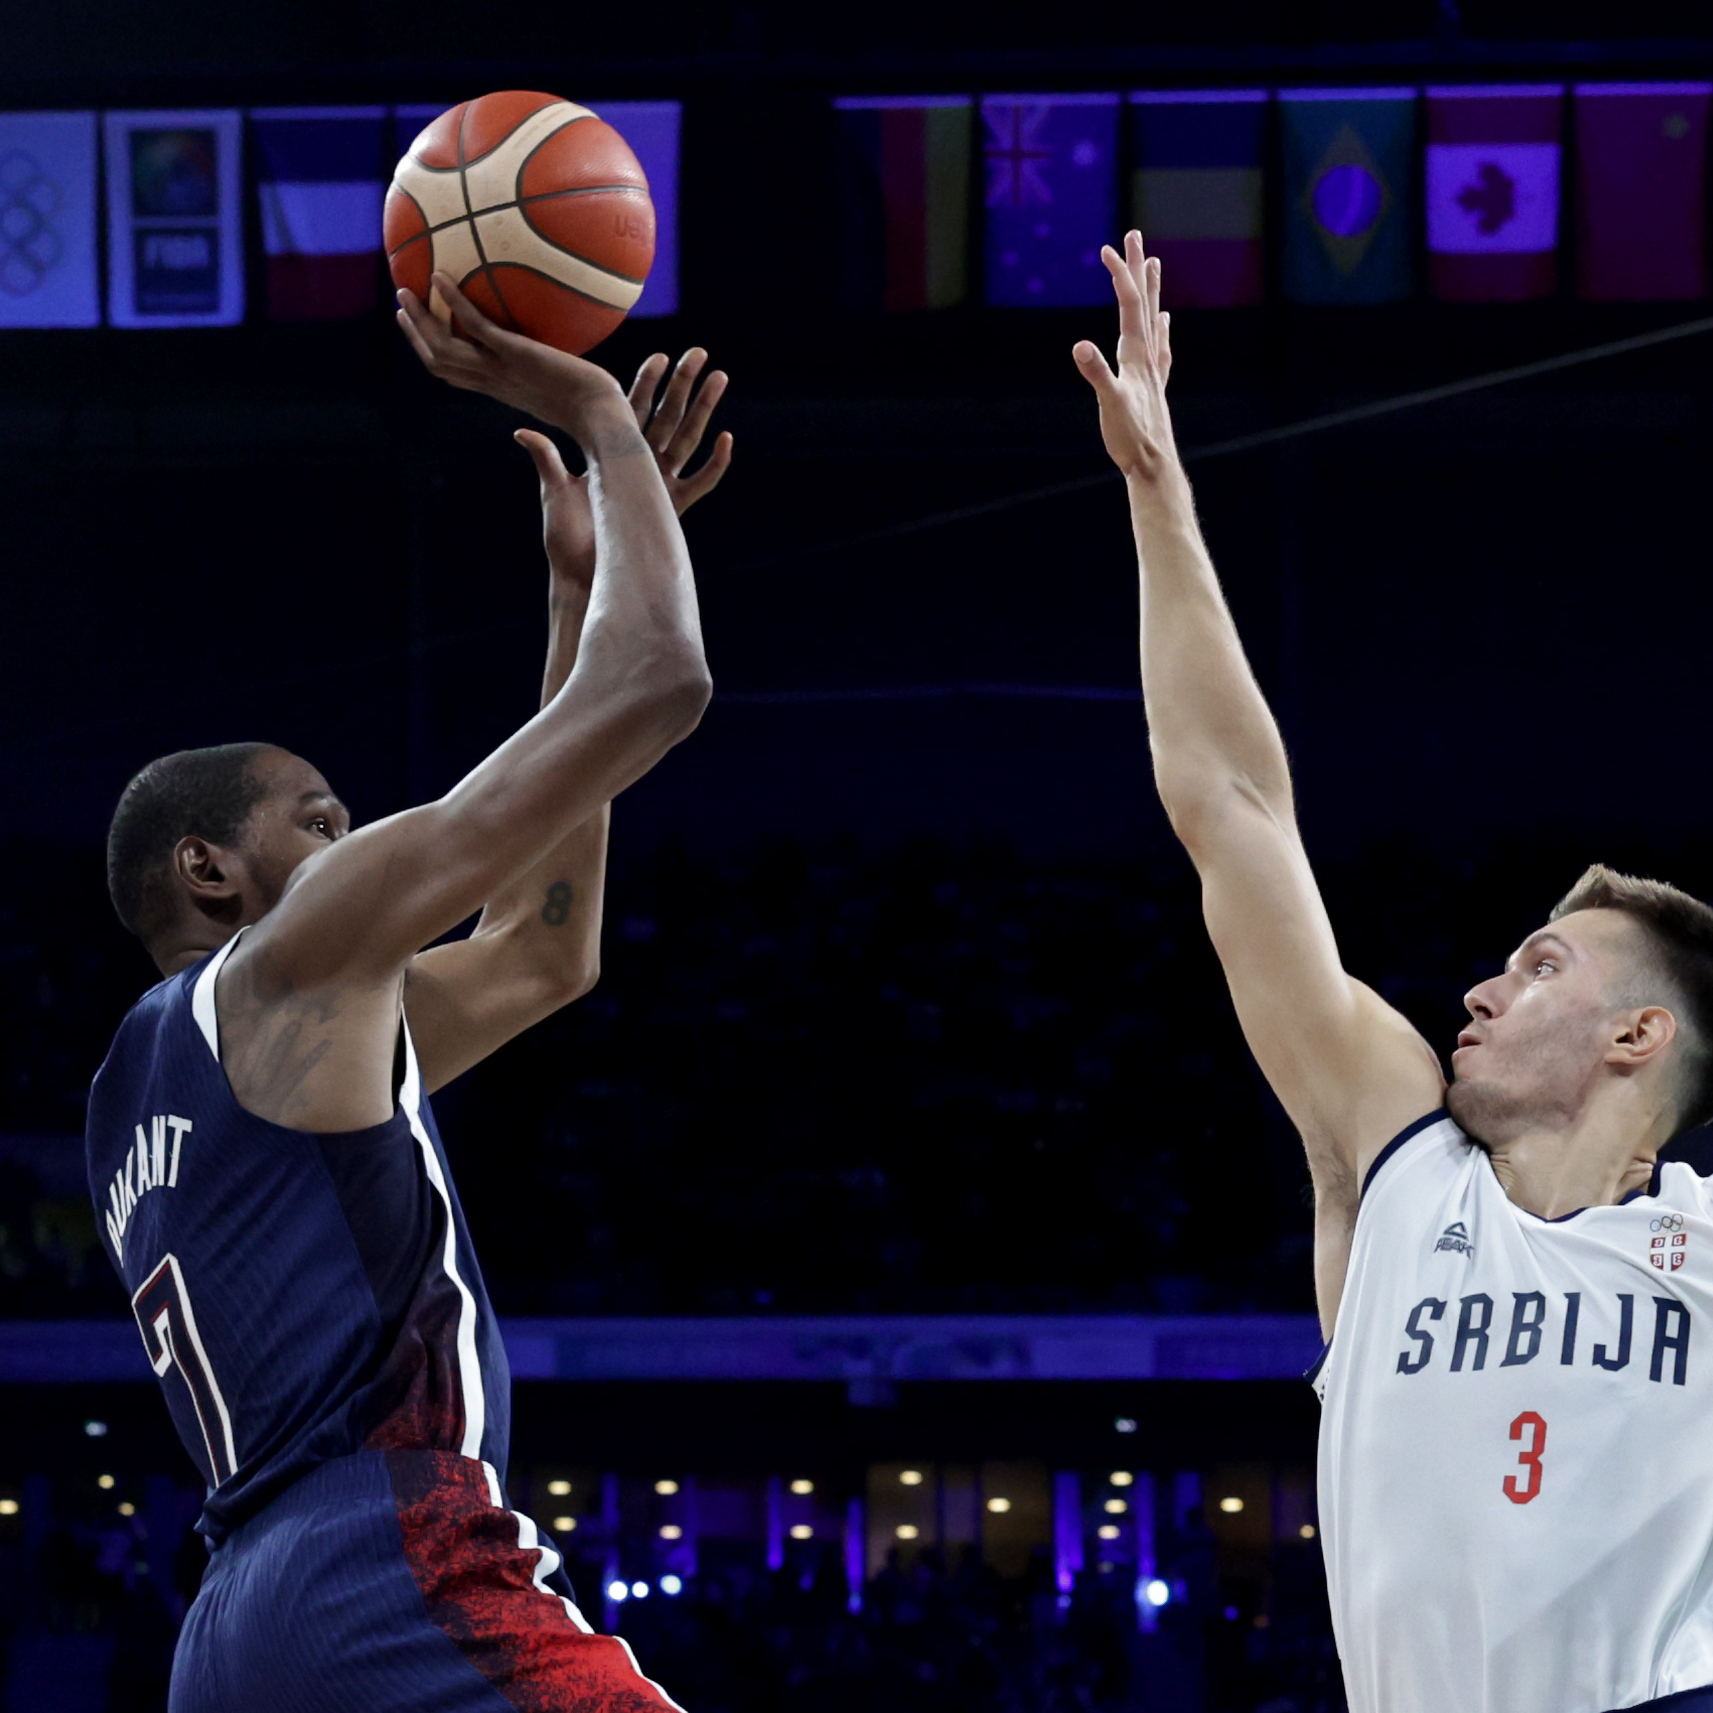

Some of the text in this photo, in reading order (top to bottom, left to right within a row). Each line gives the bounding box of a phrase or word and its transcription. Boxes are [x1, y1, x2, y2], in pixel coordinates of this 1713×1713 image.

[105, 1114, 193, 1269] DURANT
[132, 1253, 238, 1488] 7
[1396, 1290, 1691, 1387] SRBIJA
[1503, 1411, 1547, 1504] 3
